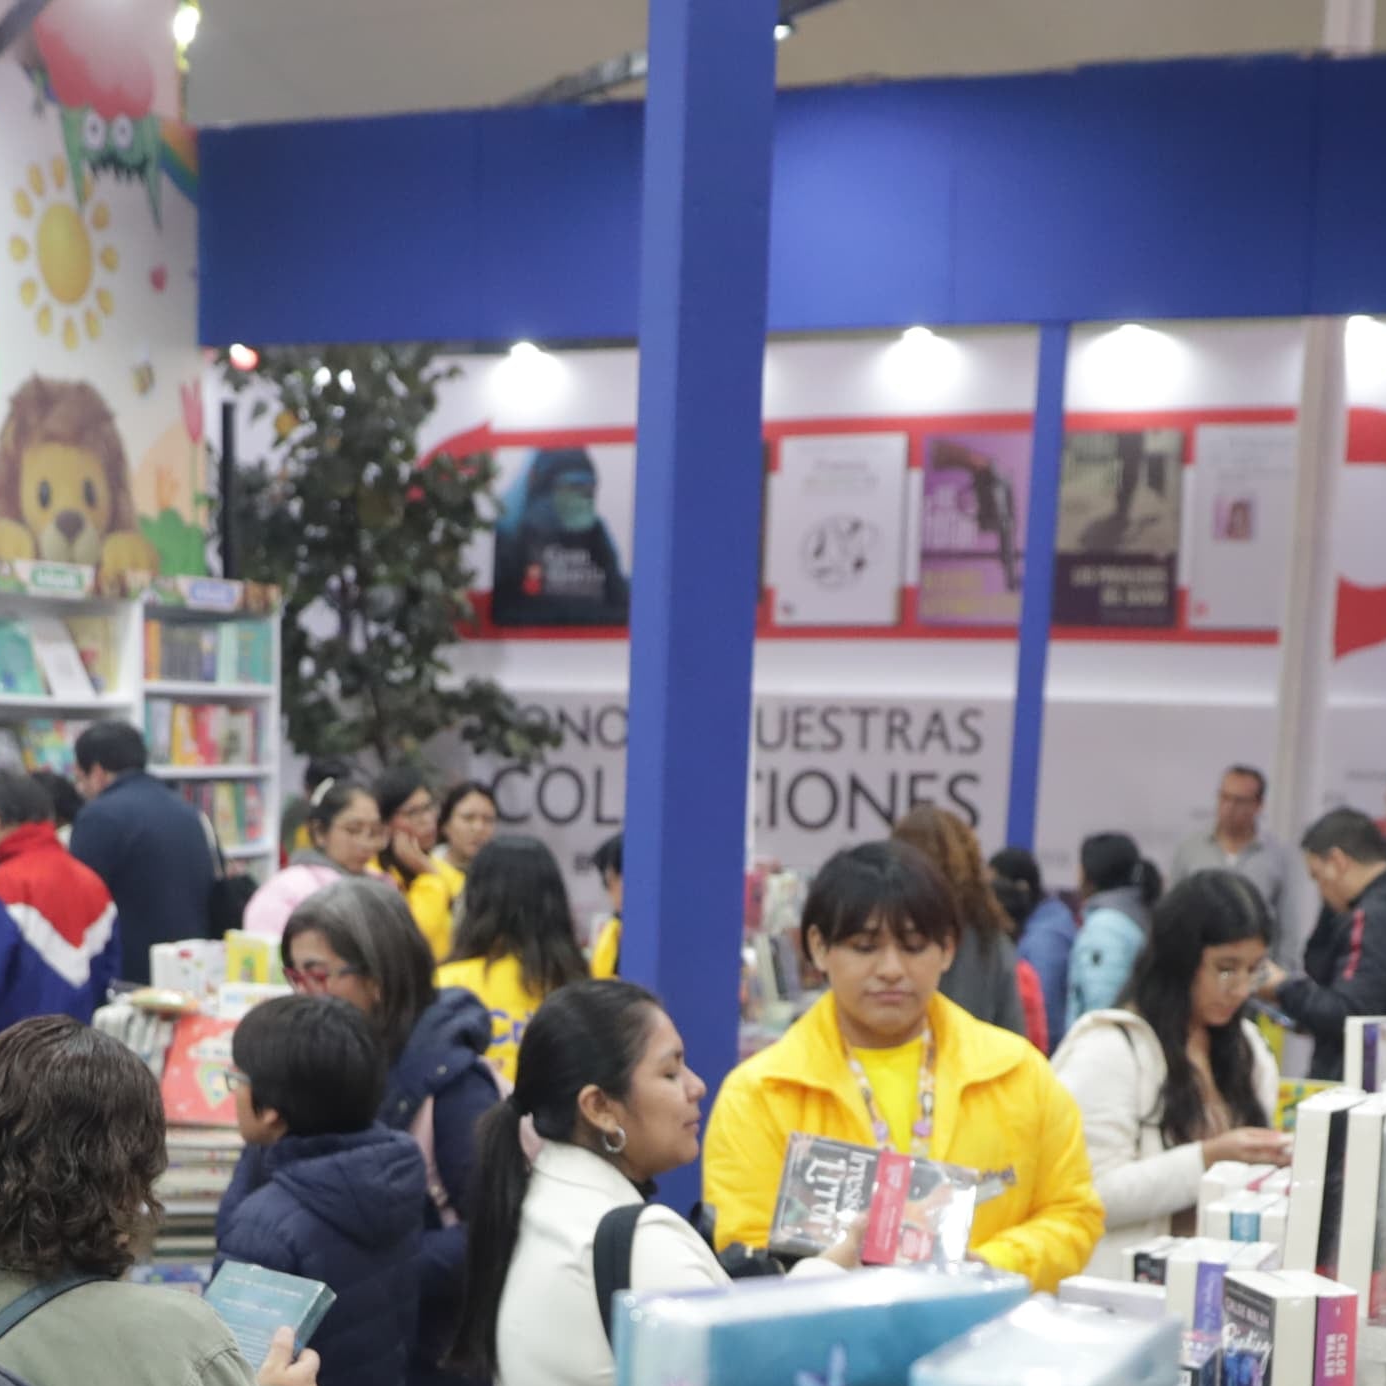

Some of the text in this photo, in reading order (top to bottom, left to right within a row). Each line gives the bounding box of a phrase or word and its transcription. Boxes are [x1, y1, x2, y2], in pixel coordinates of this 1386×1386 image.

[756, 706, 984, 756] UESTRAS
[1324, 1333, 1337, 1378] WALSH
[1335, 1333, 1348, 1377] CHLOE
